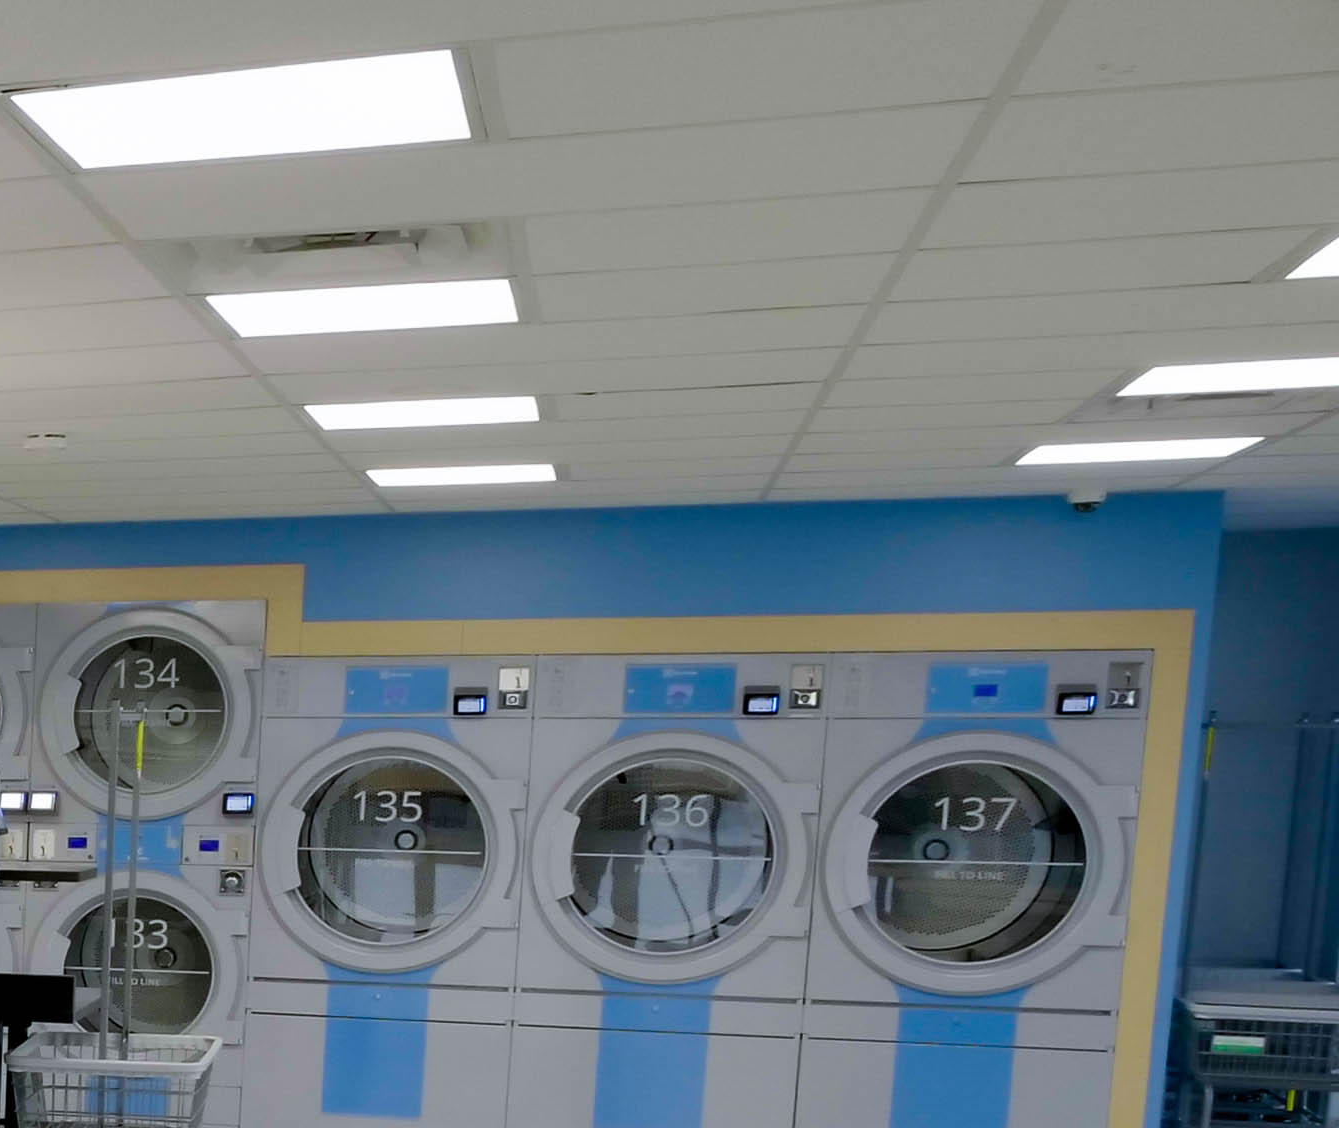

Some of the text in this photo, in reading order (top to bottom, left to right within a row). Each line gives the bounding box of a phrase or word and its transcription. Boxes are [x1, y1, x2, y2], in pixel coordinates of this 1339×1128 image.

[114, 657, 180, 689] 134
[353, 790, 422, 822] 135
[633, 794, 712, 827] 136
[934, 797, 1017, 831] 137
